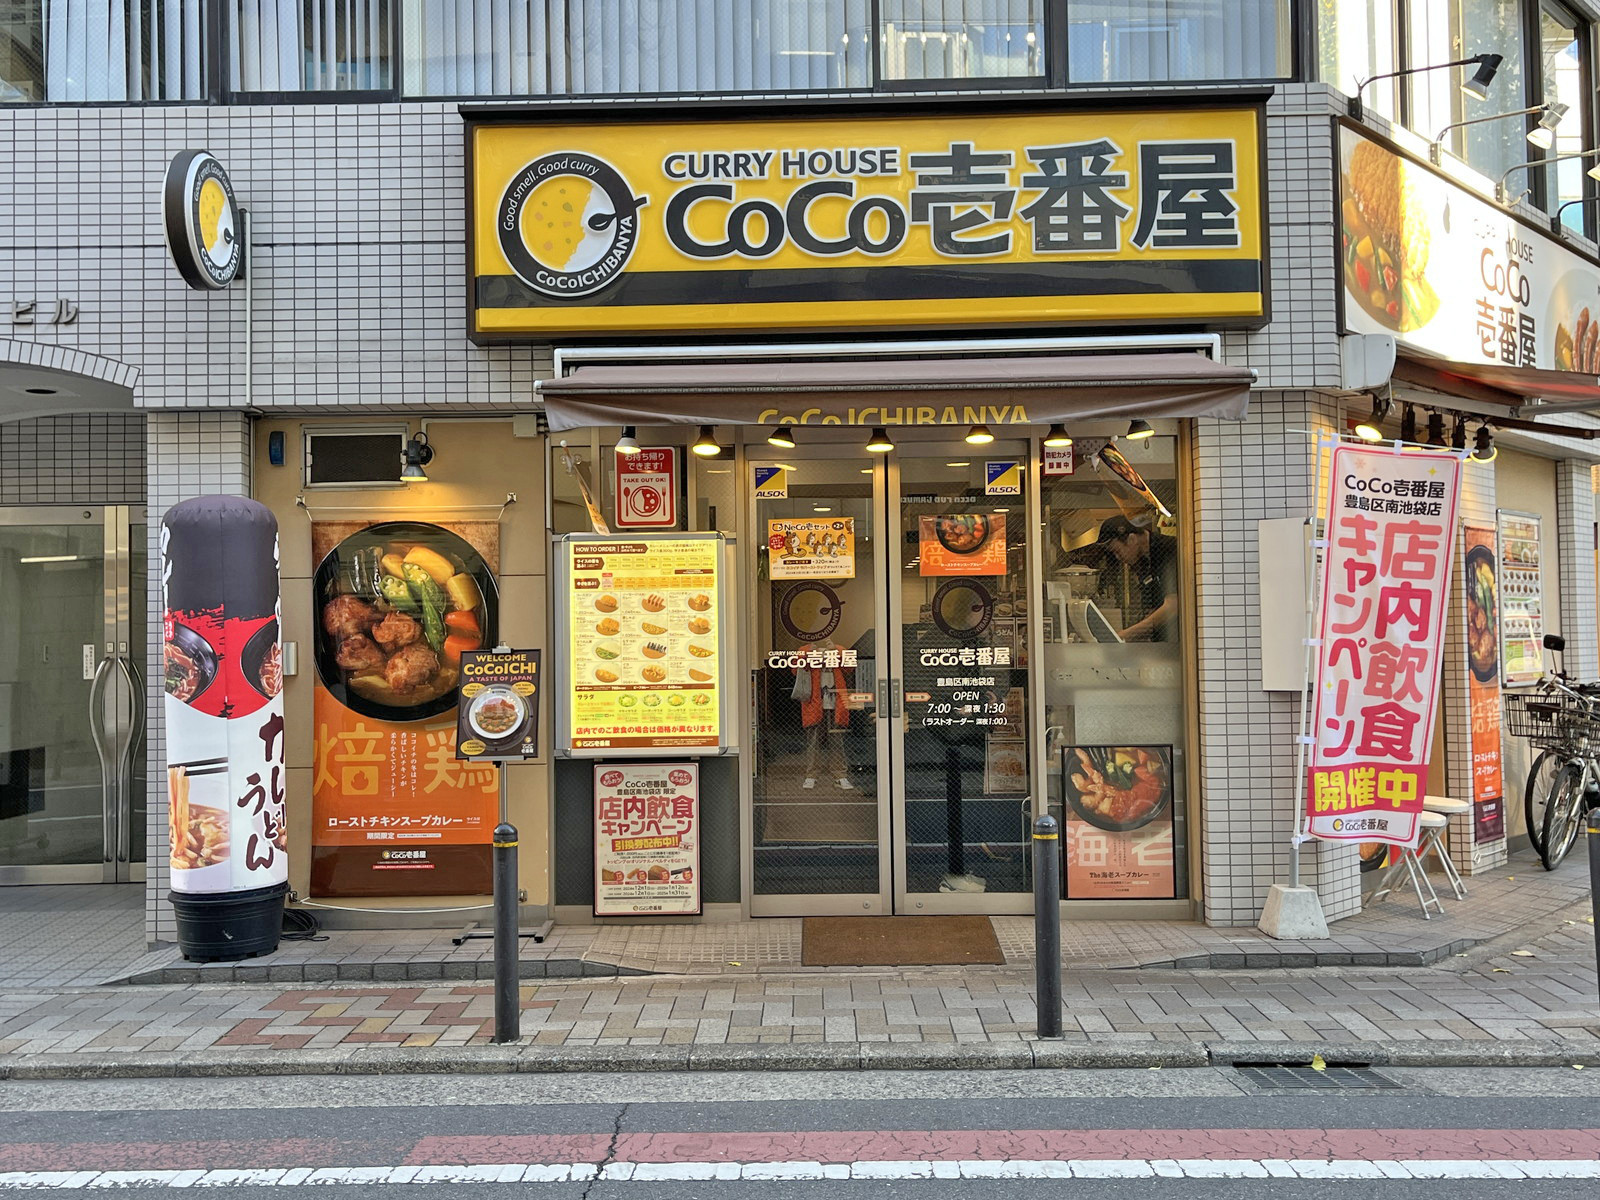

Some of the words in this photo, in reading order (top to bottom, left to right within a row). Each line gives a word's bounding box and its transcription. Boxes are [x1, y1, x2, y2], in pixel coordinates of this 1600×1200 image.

[665, 151, 775, 179] CURRY
[782, 149, 900, 177] HOUSE
[503, 197, 519, 231] Good
[513, 170, 539, 200] smell.
[537, 157, 568, 176] Good
[570, 160, 600, 176] curry
[666, 138, 1239, 257] CoCo壱番屋
[535, 215, 633, 289] CoCoICHIBANYA
[1480, 247, 1531, 307] CoCo
[11, 299, 78, 326] ビル
[1475, 296, 1536, 369] 壱番屋
[625, 452, 665, 461] お持ち帰り
[1045, 451, 1072, 459] 防犯カメラ
[1344, 474, 1445, 499] CoCo壱番屋
[1344, 494, 1442, 516] 豊島区南池袋店
[1322, 514, 1378, 759] キャンペーン
[1355, 520, 1443, 761] 店内飲食
[476, 654, 526, 662] WELCOME
[768, 649, 858, 668] CoCo壱番屋
[920, 647, 1010, 666] CoCo壱番屋
[463, 662, 537, 675] CoCoICHI
[937, 677, 995, 687] 豊島区南池袋店
[952, 691, 980, 700] OPEN
[927, 703, 951, 713] 7:00
[964, 704, 980, 713] 深夜
[983, 703, 1005, 713] 1:30
[576, 725, 715, 735] 店内でのご飲食の場合は価格が異なります。
[1313, 767, 1418, 813] 開催中
[599, 795, 695, 820] 店内飲食
[237, 772, 279, 872] うどん
[328, 815, 463, 827] ローストチキンスープカレー
[601, 818, 693, 836] キャンペーン
[1345, 818, 1388, 832] CoCo壱番屋
[366, 832, 395, 840] 期間限定
